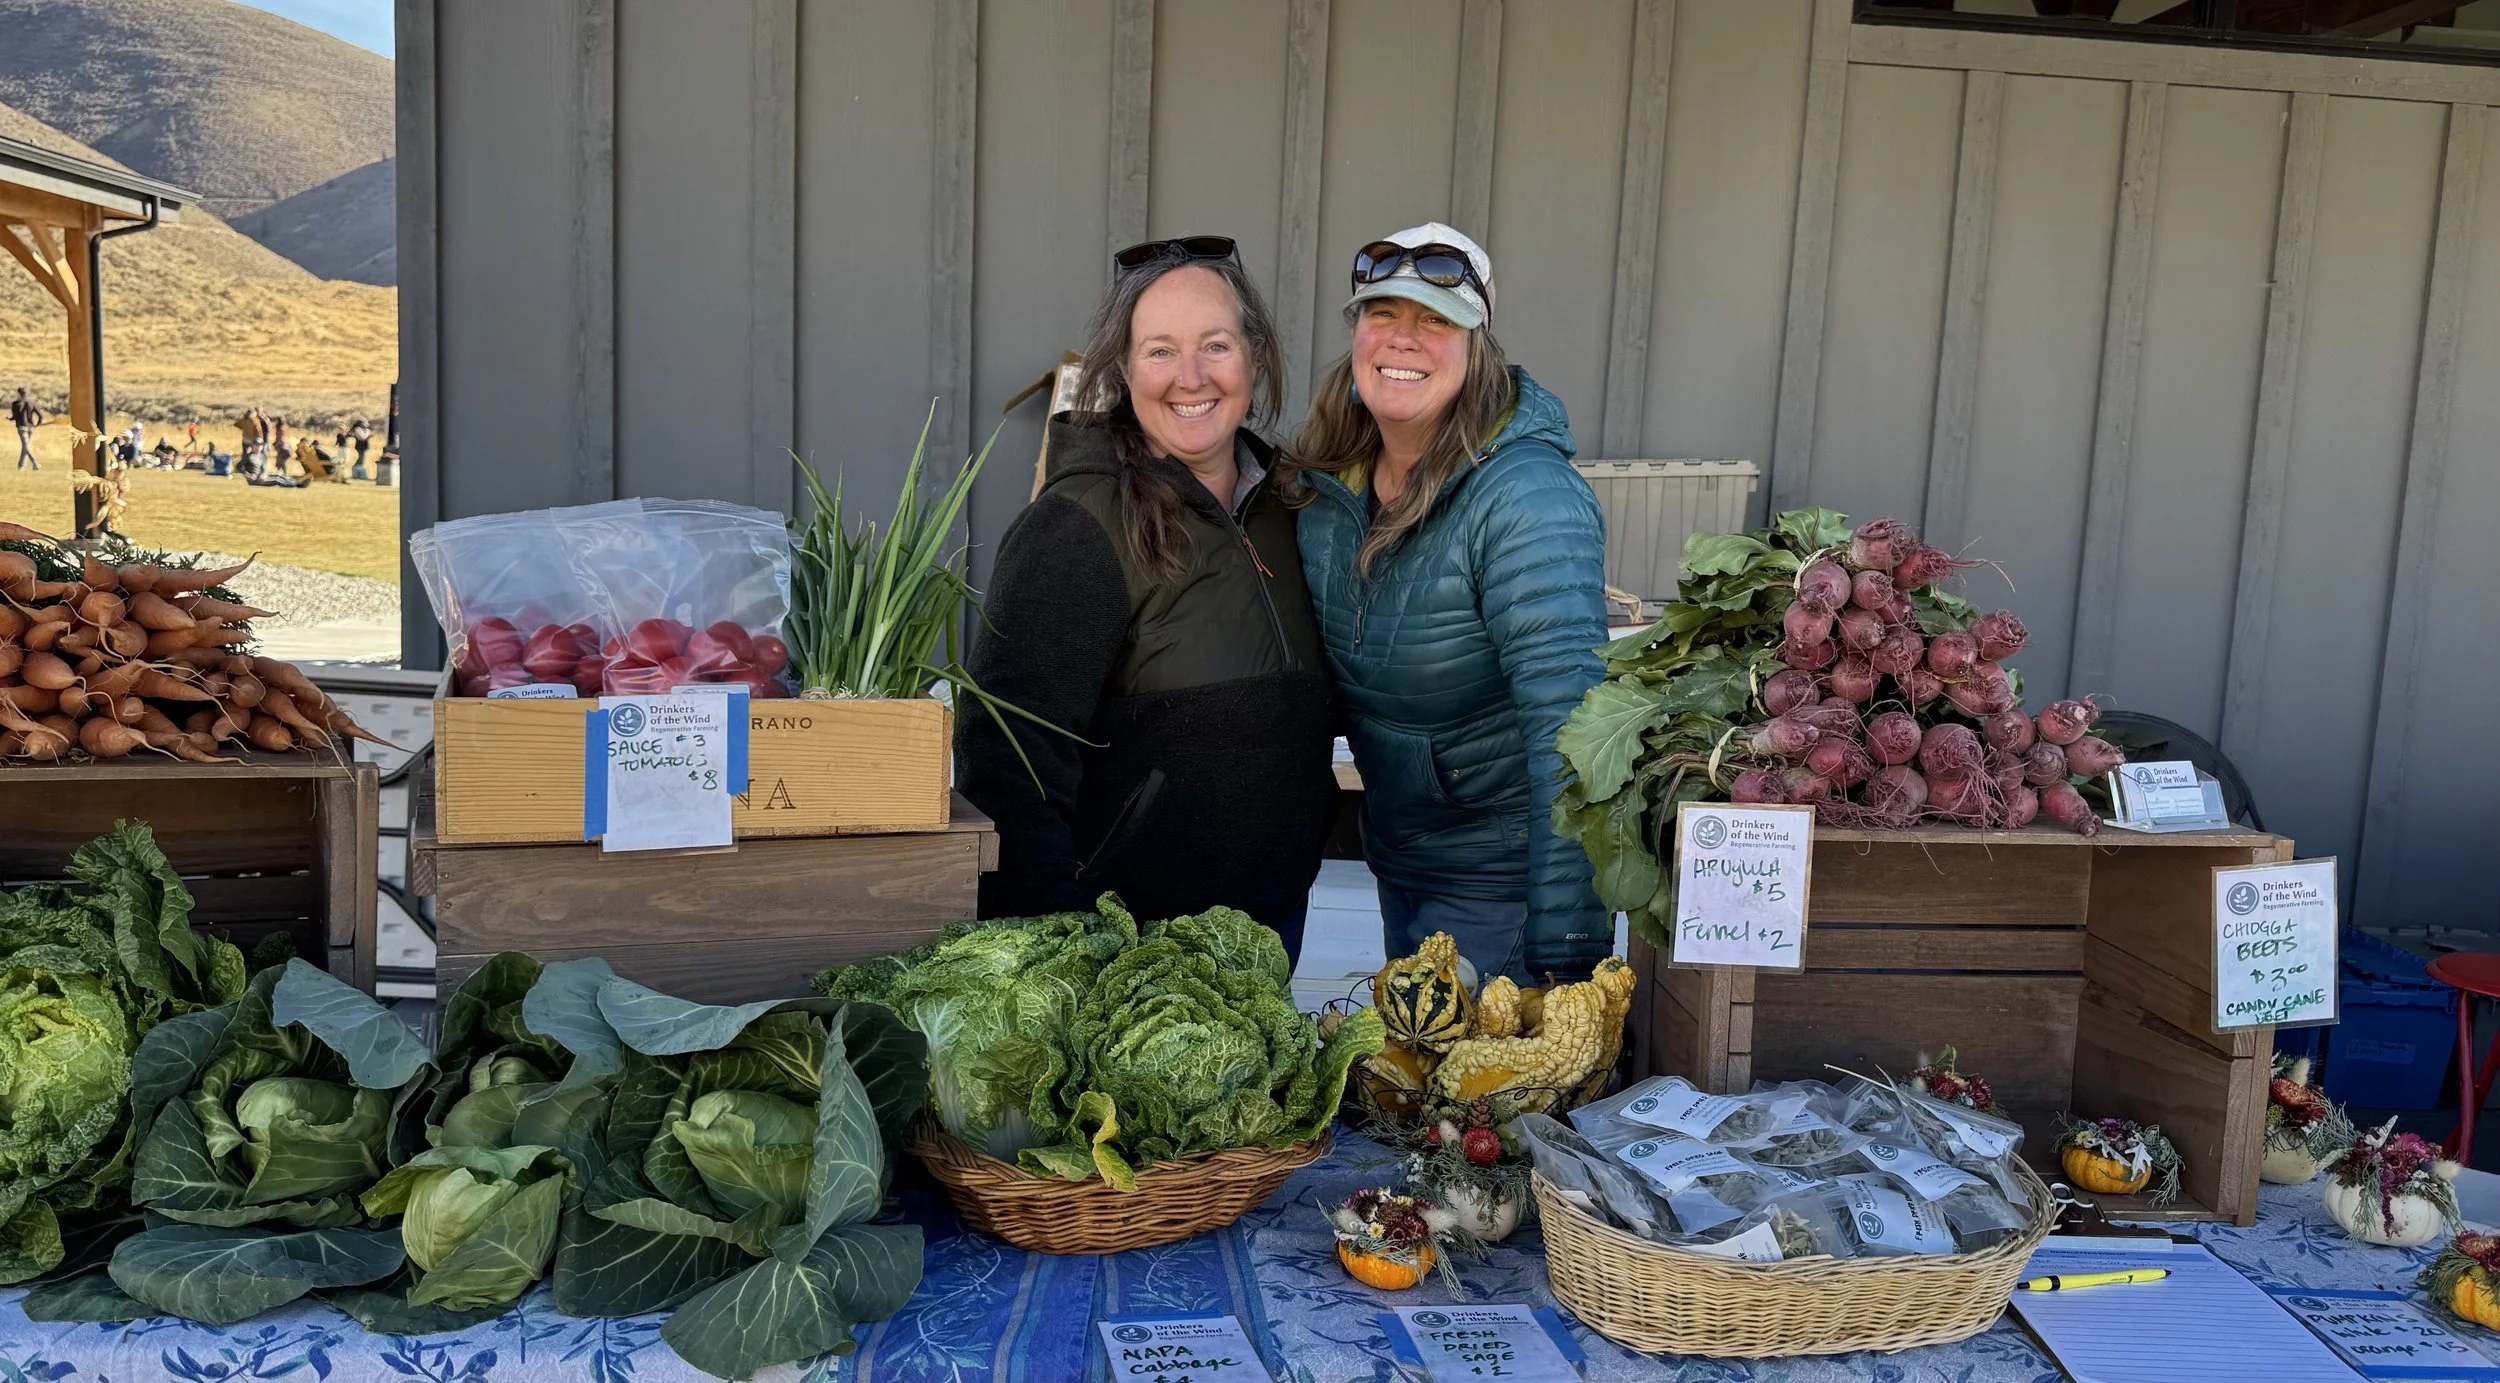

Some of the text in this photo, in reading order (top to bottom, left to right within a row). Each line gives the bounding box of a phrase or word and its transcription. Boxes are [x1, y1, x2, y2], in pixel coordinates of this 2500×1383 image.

[650, 705, 695, 714] Drinkers
[650, 714, 711, 725] of the Wind
[651, 725, 719, 734] Regenerative Farming
[608, 738, 663, 758] SAUCE
[619, 754, 708, 772] TOMATOES
[1732, 820, 1775, 830] Drinkers
[1730, 830, 1789, 841] of the Wind
[1730, 841, 1770, 850] Regenerative
[2263, 880, 2303, 891] Drinkers
[2262, 888, 2317, 902] of the Wind
[1682, 916, 1793, 951] Fennel $2
[2236, 936, 2298, 962] BEETS
[2226, 988, 2326, 1016] CANDY CANE
[2306, 1314, 2418, 1325] PUMPKINS
[1429, 1330, 1498, 1341] FRESH
[1443, 1342, 1512, 1352] DRIED
[2350, 1344, 2419, 1357] orange
[1122, 1345, 1194, 1362] NAPA
